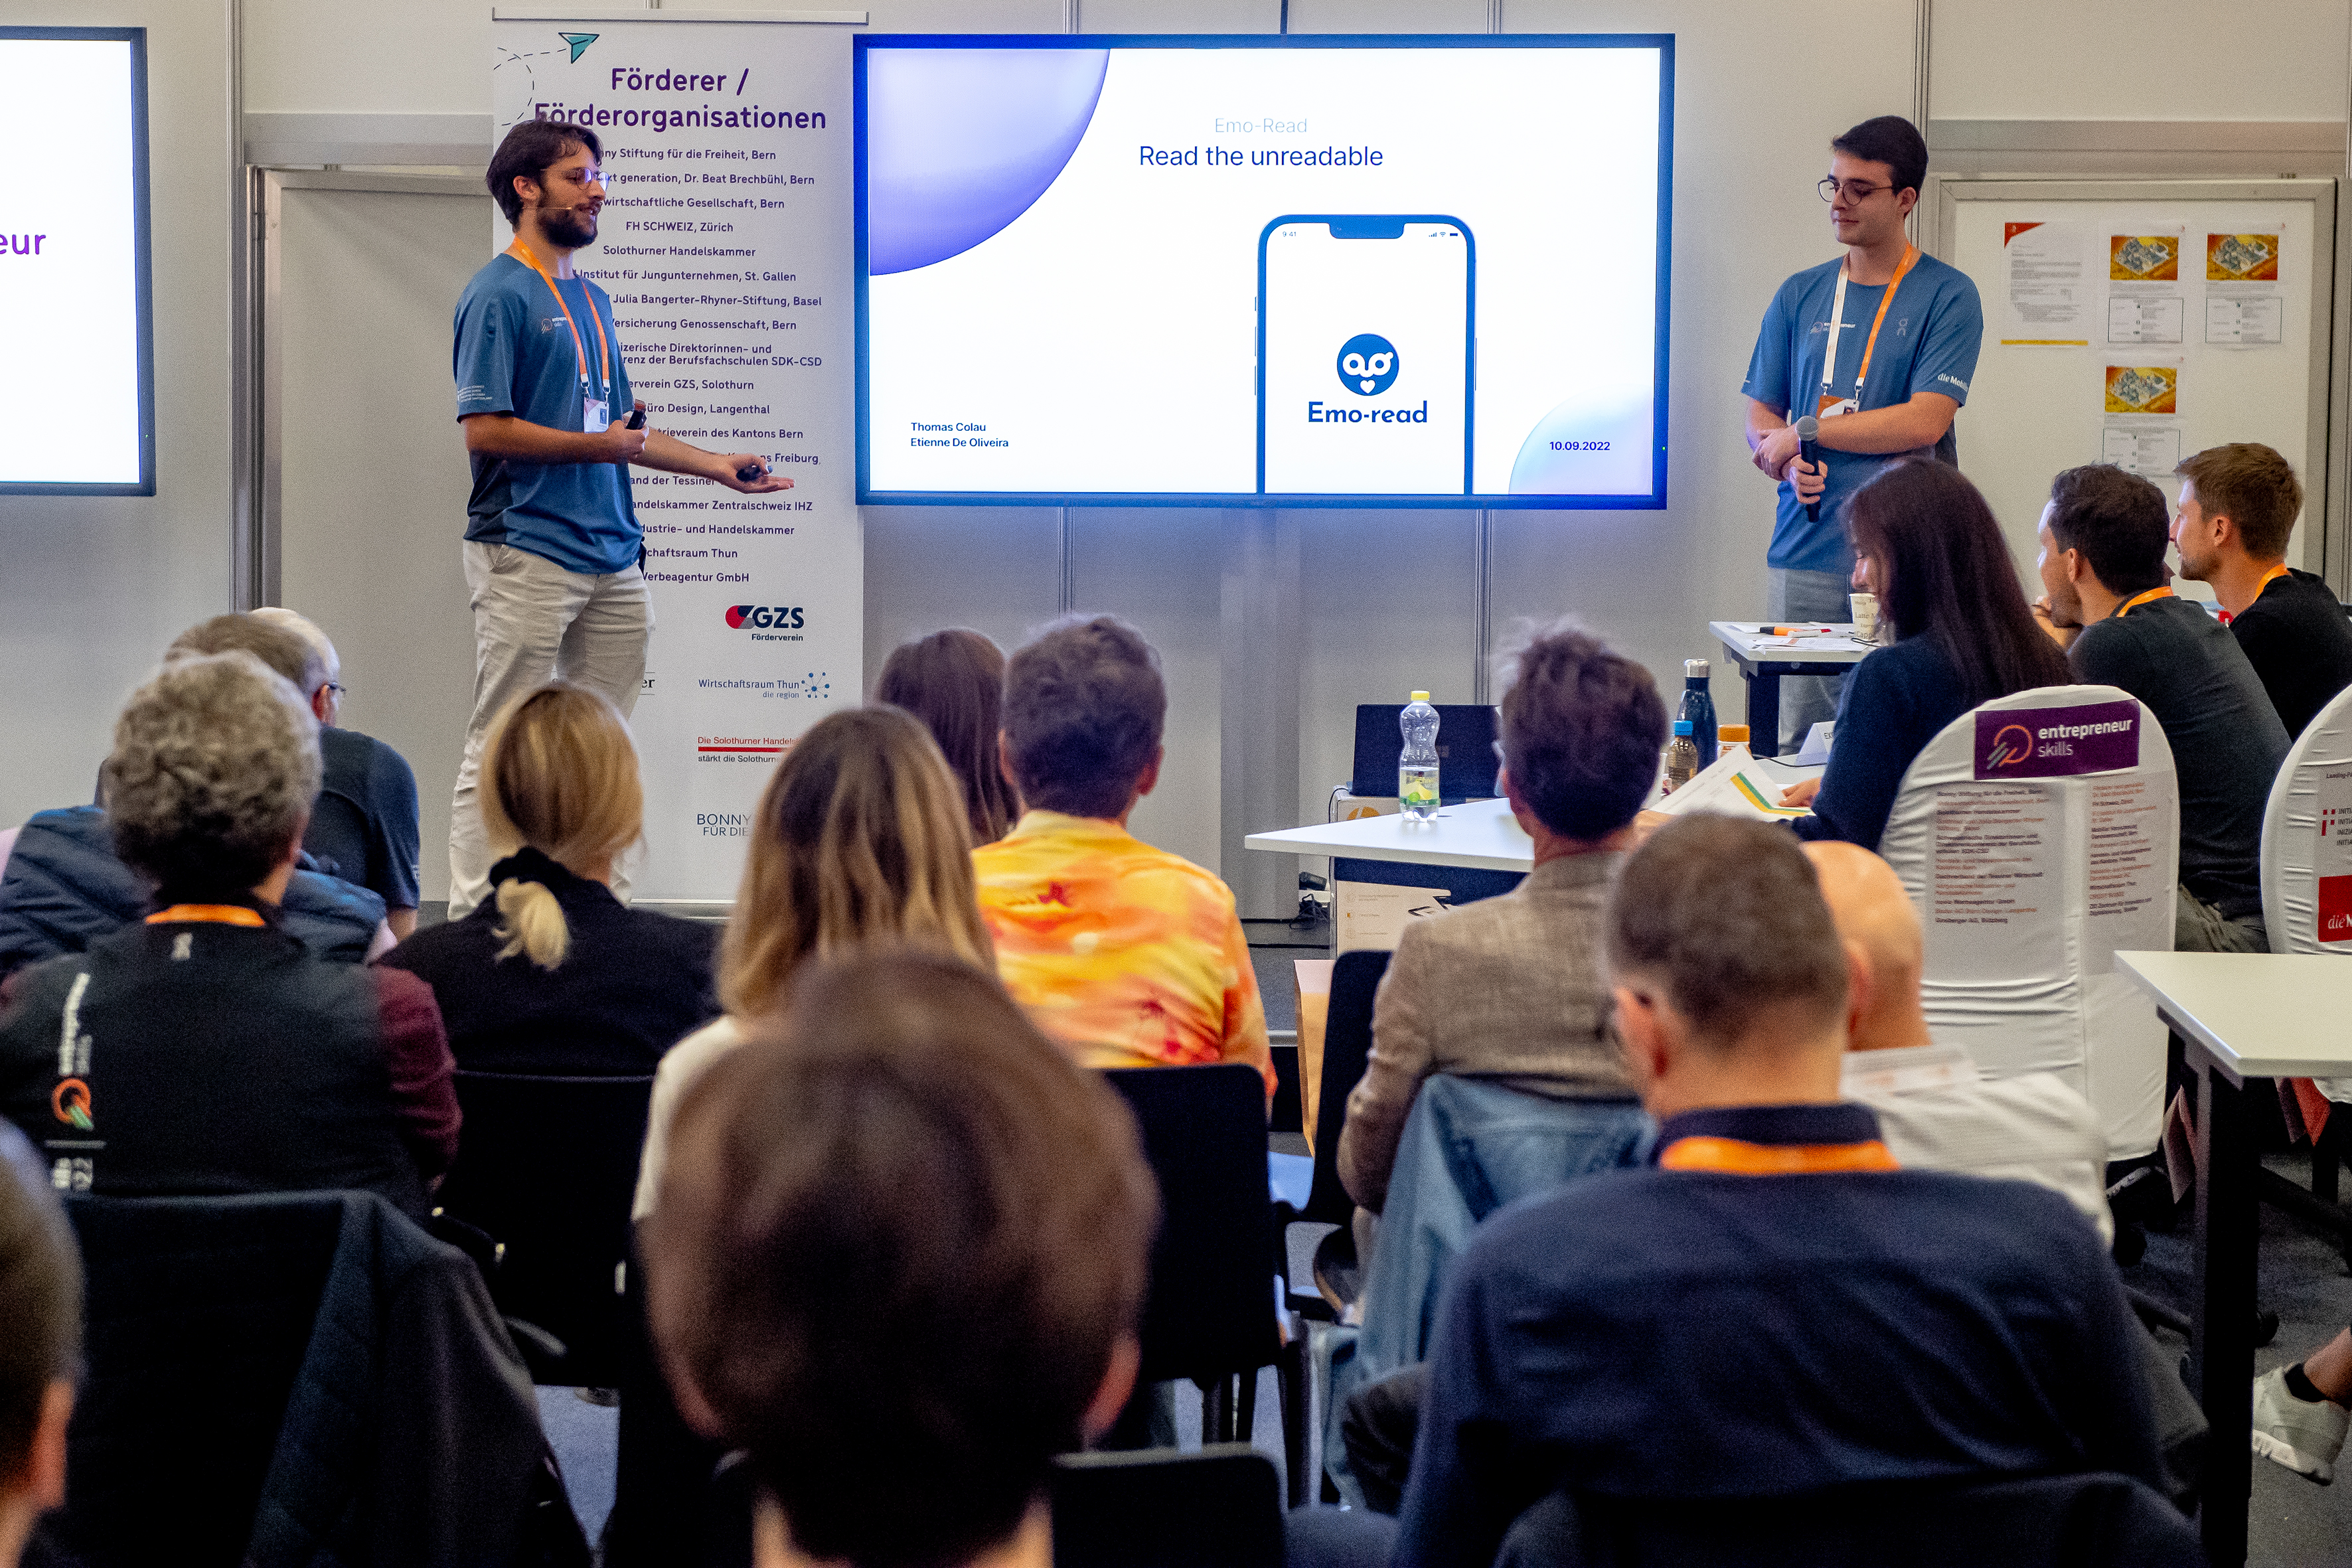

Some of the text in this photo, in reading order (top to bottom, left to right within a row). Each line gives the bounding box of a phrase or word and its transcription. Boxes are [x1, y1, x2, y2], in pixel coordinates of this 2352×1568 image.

[612, 68, 749, 96] Förderer /
[535, 103, 826, 132] Förderorganisationen
[1215, 118, 1306, 133] Emo-Read
[620, 149, 664, 160] Stiftung
[667, 149, 682, 158] für
[686, 149, 702, 159] die
[705, 149, 748, 161] Freiheit,
[752, 150, 775, 159] Bern
[1140, 146, 1383, 166] Read the unreadable
[620, 173, 680, 184] generation,
[684, 174, 698, 183] Dr.
[702, 174, 726, 183] Beat
[730, 174, 787, 186] Brechbühl,
[791, 175, 815, 184] Bern
[599, 196, 784, 210] wirtschaftliche Gesellschaft, Bern
[626, 222, 733, 233] FH SCHWEIZ, Zürich
[603, 245, 755, 256] Solothurner Handelskammer
[623, 270, 638, 279] für
[642, 270, 742, 282] Jungunternehmen,
[745, 272, 759, 281] St.
[763, 272, 796, 281] Gallen
[613, 294, 821, 307] Julia Bangerter-Rhyner-Stiftung, Basel
[680, 319, 769, 331] Genossenschaft,
[773, 321, 796, 329] Bern
[620, 343, 771, 354] izerische Direktorinnen- und
[623, 355, 822, 366] renz der Berufsfachschulen SDK-CSD
[674, 379, 698, 390] GZS,
[702, 380, 753, 389] Solothurn
[648, 403, 769, 416] üro Design, Langenthal
[1308, 400, 1427, 423] Emo-read
[911, 422, 986, 431] Thomas Colau
[711, 428, 729, 437] des
[733, 429, 775, 438] Kantons
[779, 430, 803, 438] Bern
[911, 438, 1008, 447] Etienne De Oliveira
[1550, 441, 1610, 451] 10.09.2022
[775, 453, 819, 465] Freiburg
[652, 475, 669, 486] der
[712, 501, 791, 510] Zentralschweiz
[795, 502, 813, 510] IHZ
[686, 524, 705, 533] und
[709, 524, 794, 534] Handelskammer
[647, 548, 738, 559] chaftsraum Thun
[716, 573, 749, 582] GmbH
[753, 607, 804, 629] GZS
[698, 679, 774, 688] Wirtschaftsraum
[2039, 719, 2132, 740] entrepreneur
[2039, 742, 2073, 757] skills
[703, 825, 726, 836] FÜR
